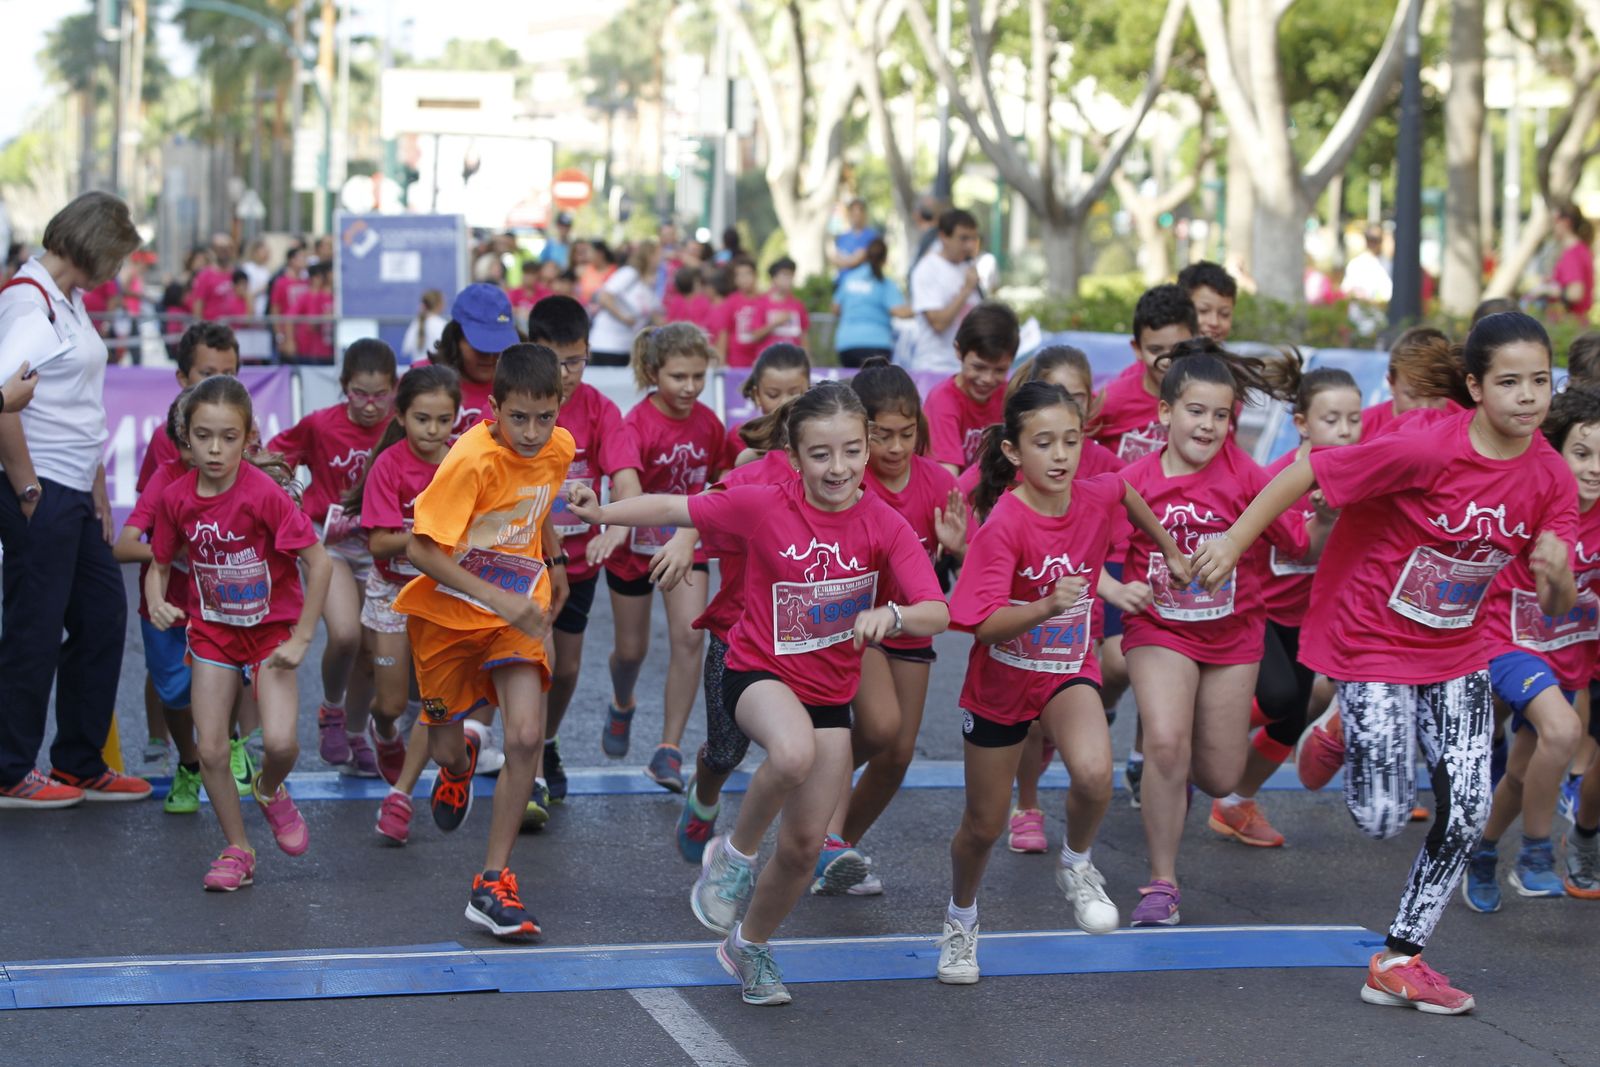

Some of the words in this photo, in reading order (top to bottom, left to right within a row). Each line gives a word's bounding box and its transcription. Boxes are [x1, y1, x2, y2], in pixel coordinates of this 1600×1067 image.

[478, 564, 532, 594] 1706
[818, 580, 846, 593] CARRERA
[847, 576, 874, 590] SOLIDARIA
[216, 581, 268, 603] 1646
[1028, 624, 1085, 647] 1741
